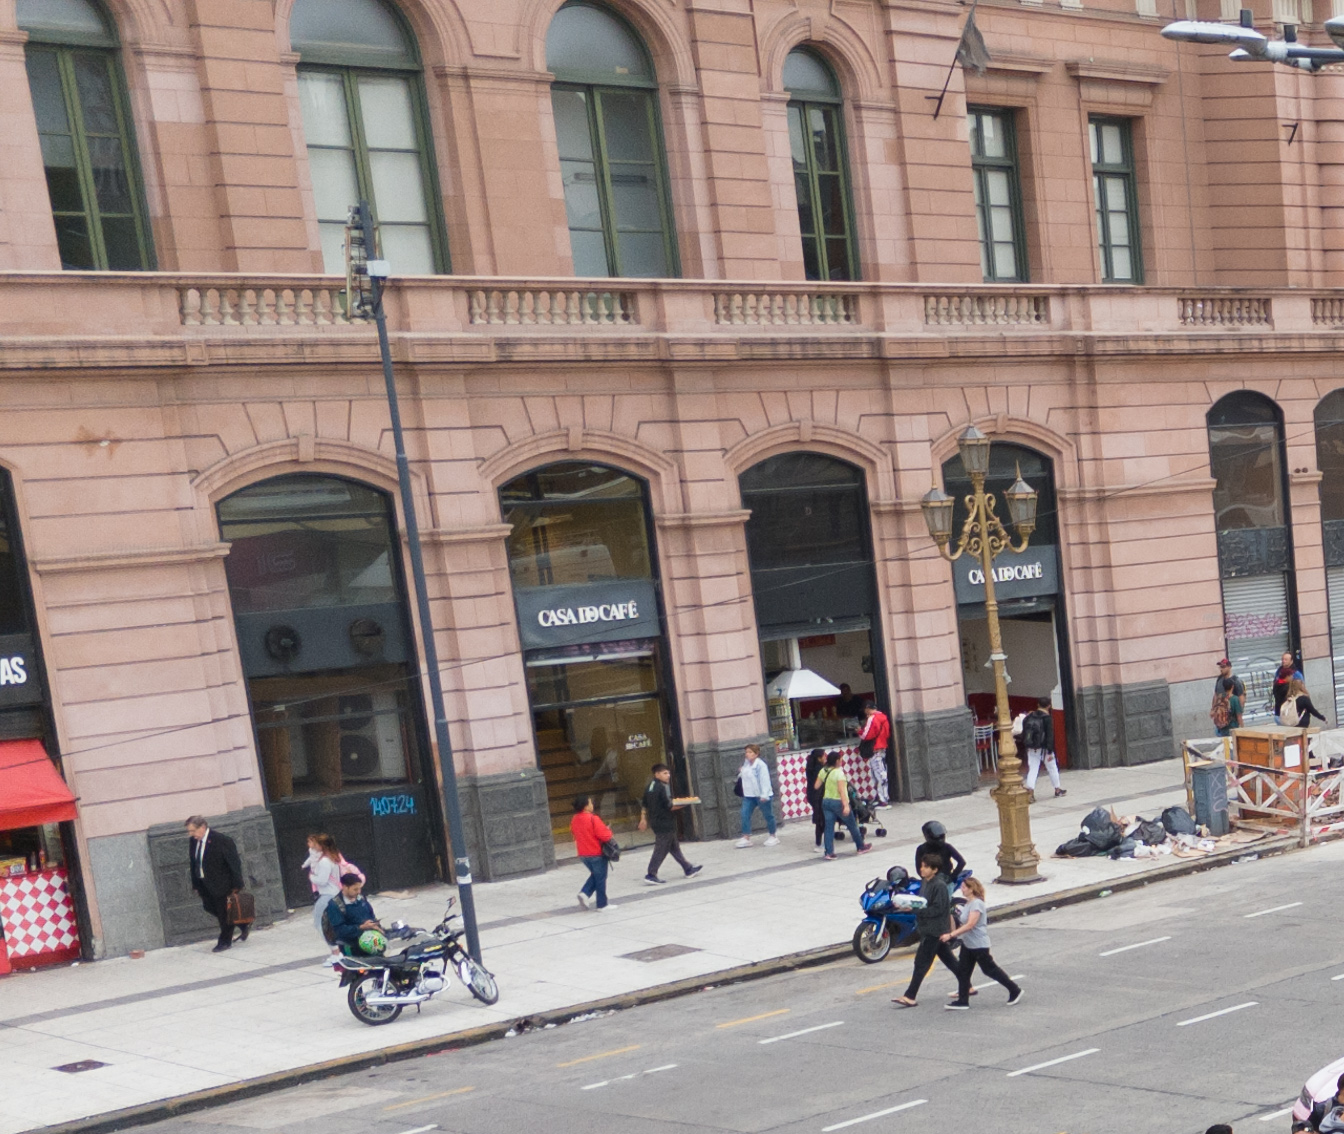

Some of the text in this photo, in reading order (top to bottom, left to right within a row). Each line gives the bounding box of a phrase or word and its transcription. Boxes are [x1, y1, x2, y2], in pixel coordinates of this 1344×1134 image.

[968, 569, 999, 585] CAA
[538, 607, 579, 628] CASA
[578, 605, 599, 624] DO
[0, 656, 28, 687] AS
